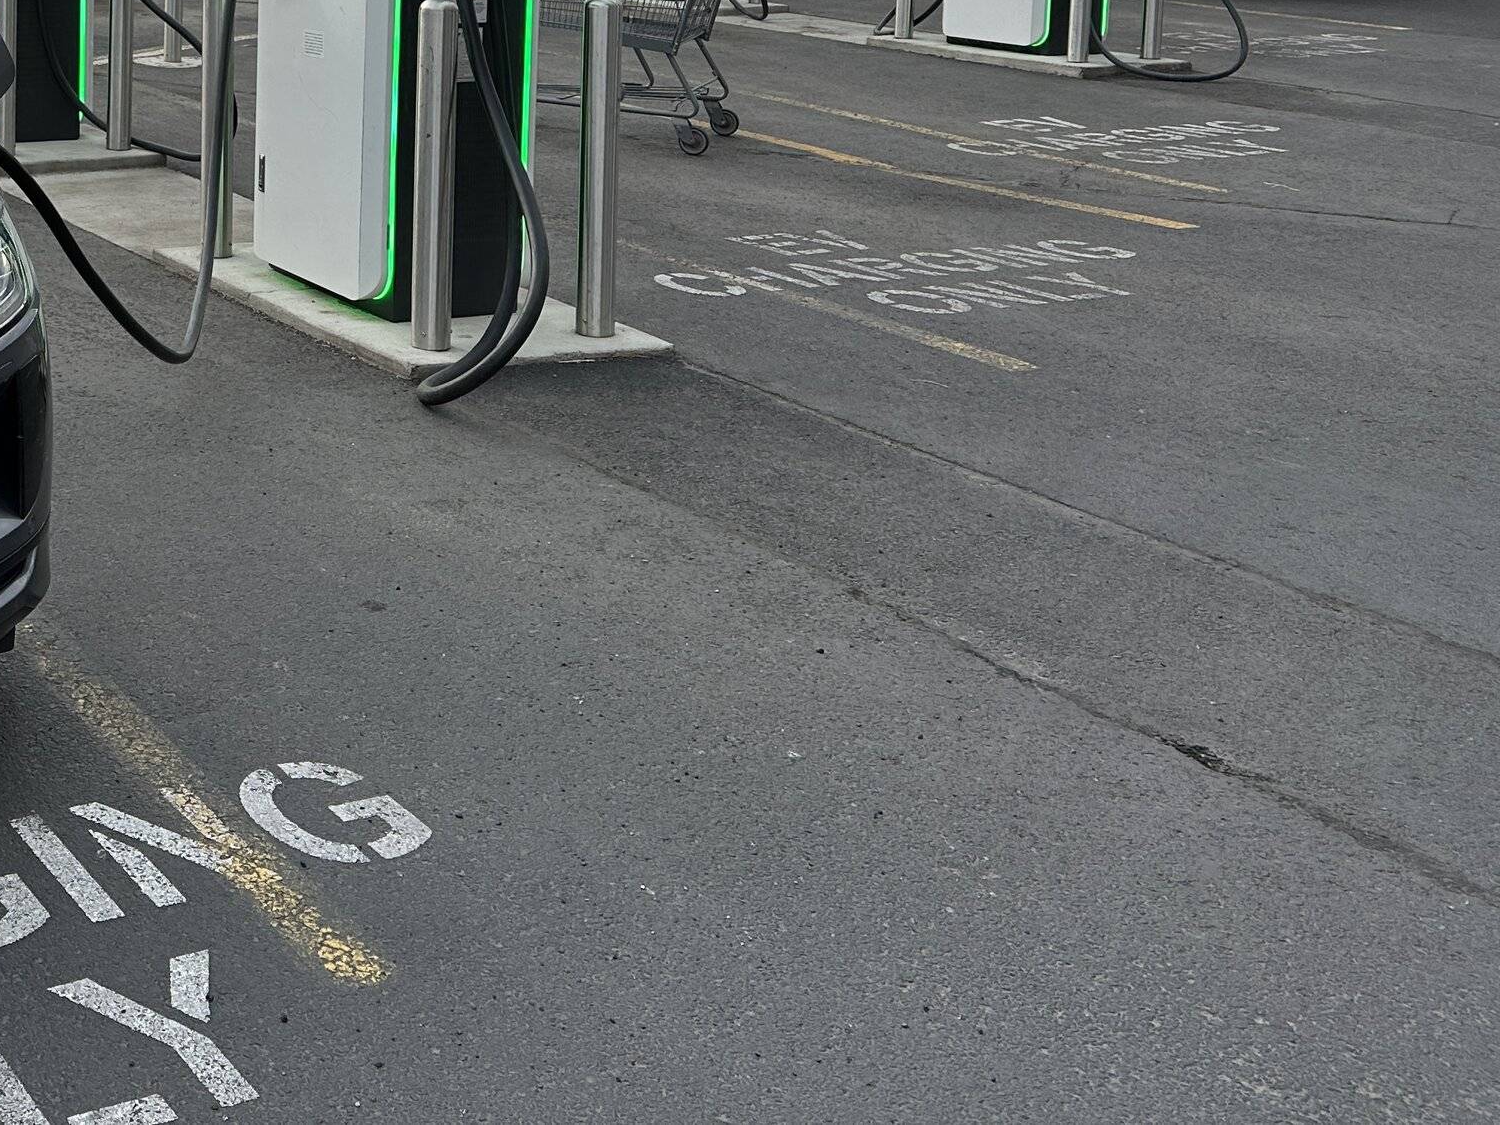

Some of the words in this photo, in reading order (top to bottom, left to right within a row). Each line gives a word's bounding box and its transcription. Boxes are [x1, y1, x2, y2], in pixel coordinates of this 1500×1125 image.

[724, 229, 870, 255] EV
[653, 239, 1137, 296] CHARGING
[866, 271, 1131, 314] ONLY
